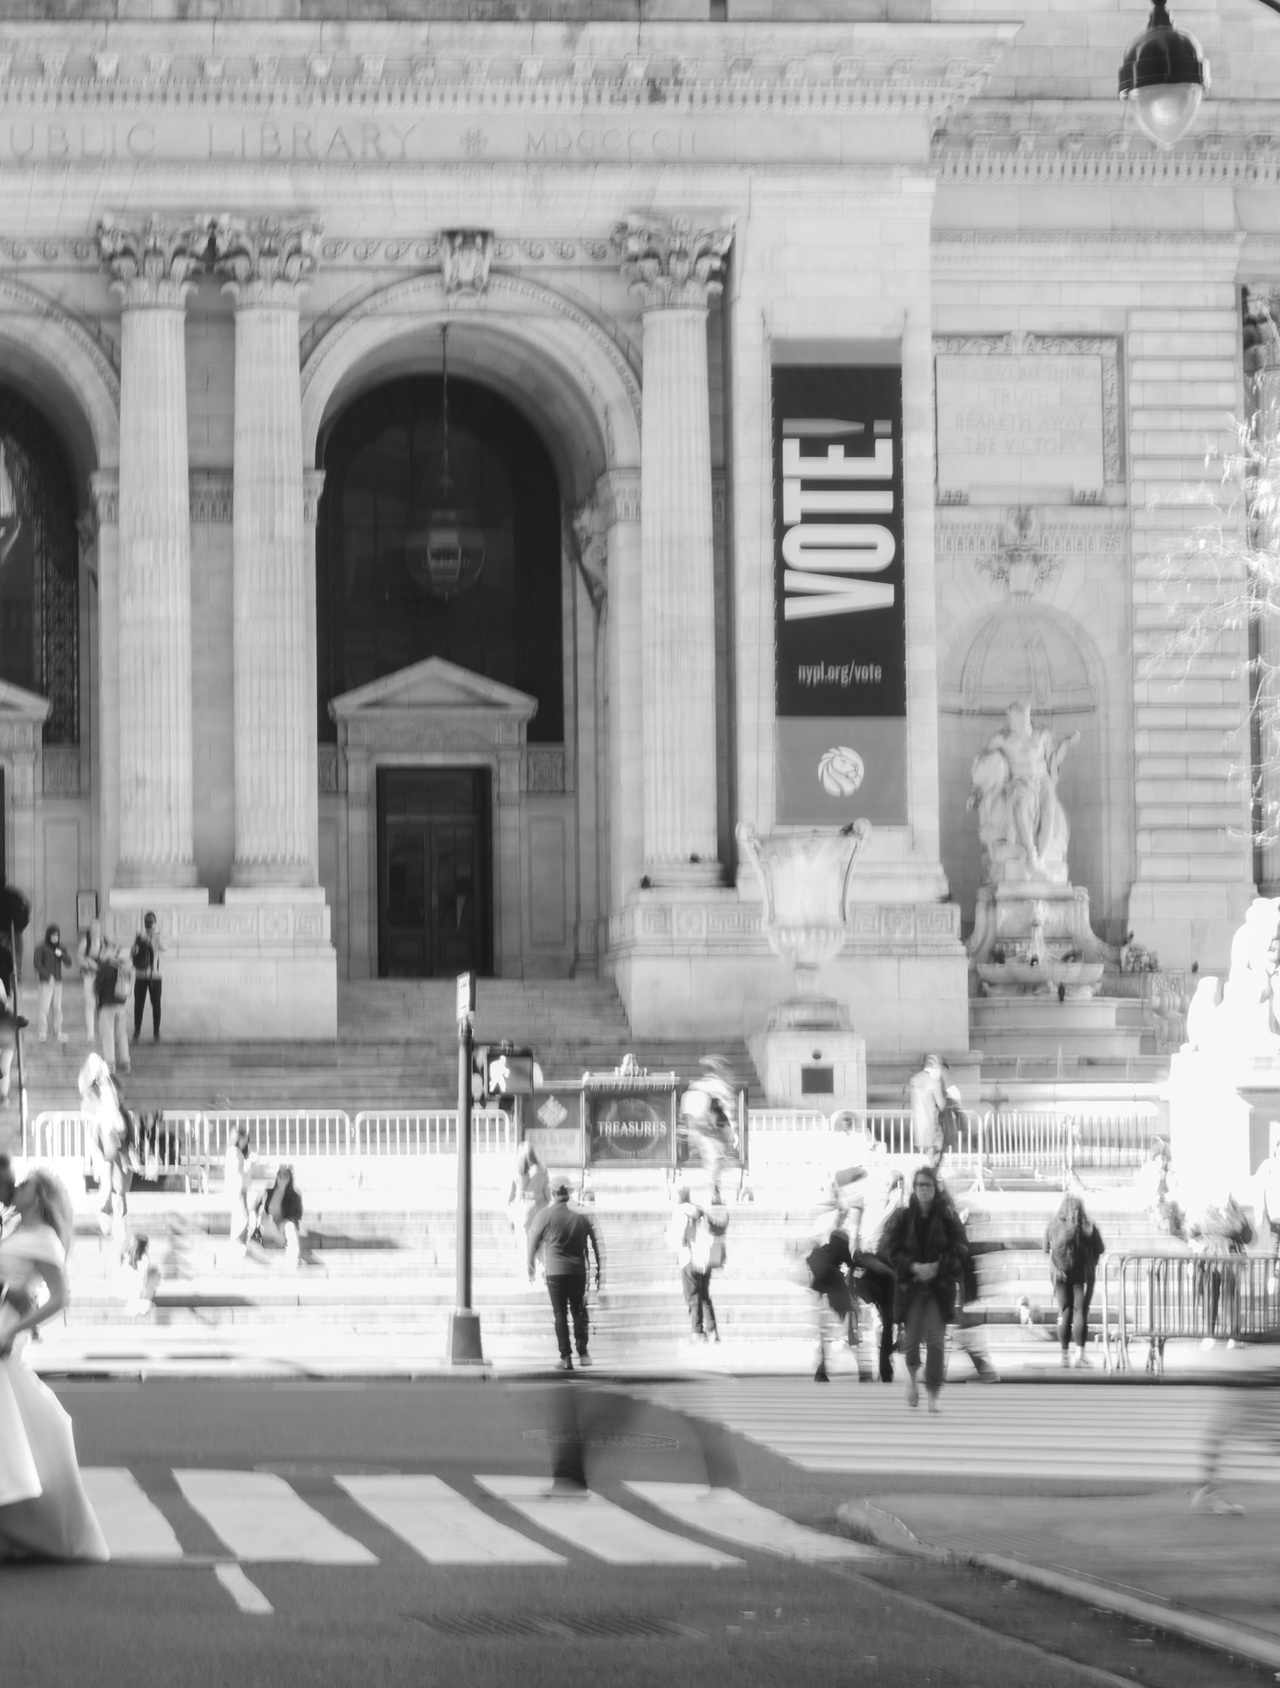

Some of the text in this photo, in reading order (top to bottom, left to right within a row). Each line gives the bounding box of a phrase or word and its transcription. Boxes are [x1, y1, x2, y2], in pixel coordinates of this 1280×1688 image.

[208, 121, 418, 160] LIBRARY
[782, 418, 896, 621] VOTE!
[798, 659, 883, 689] nypl.org/vote
[597, 1120, 667, 1138] TREASURES
